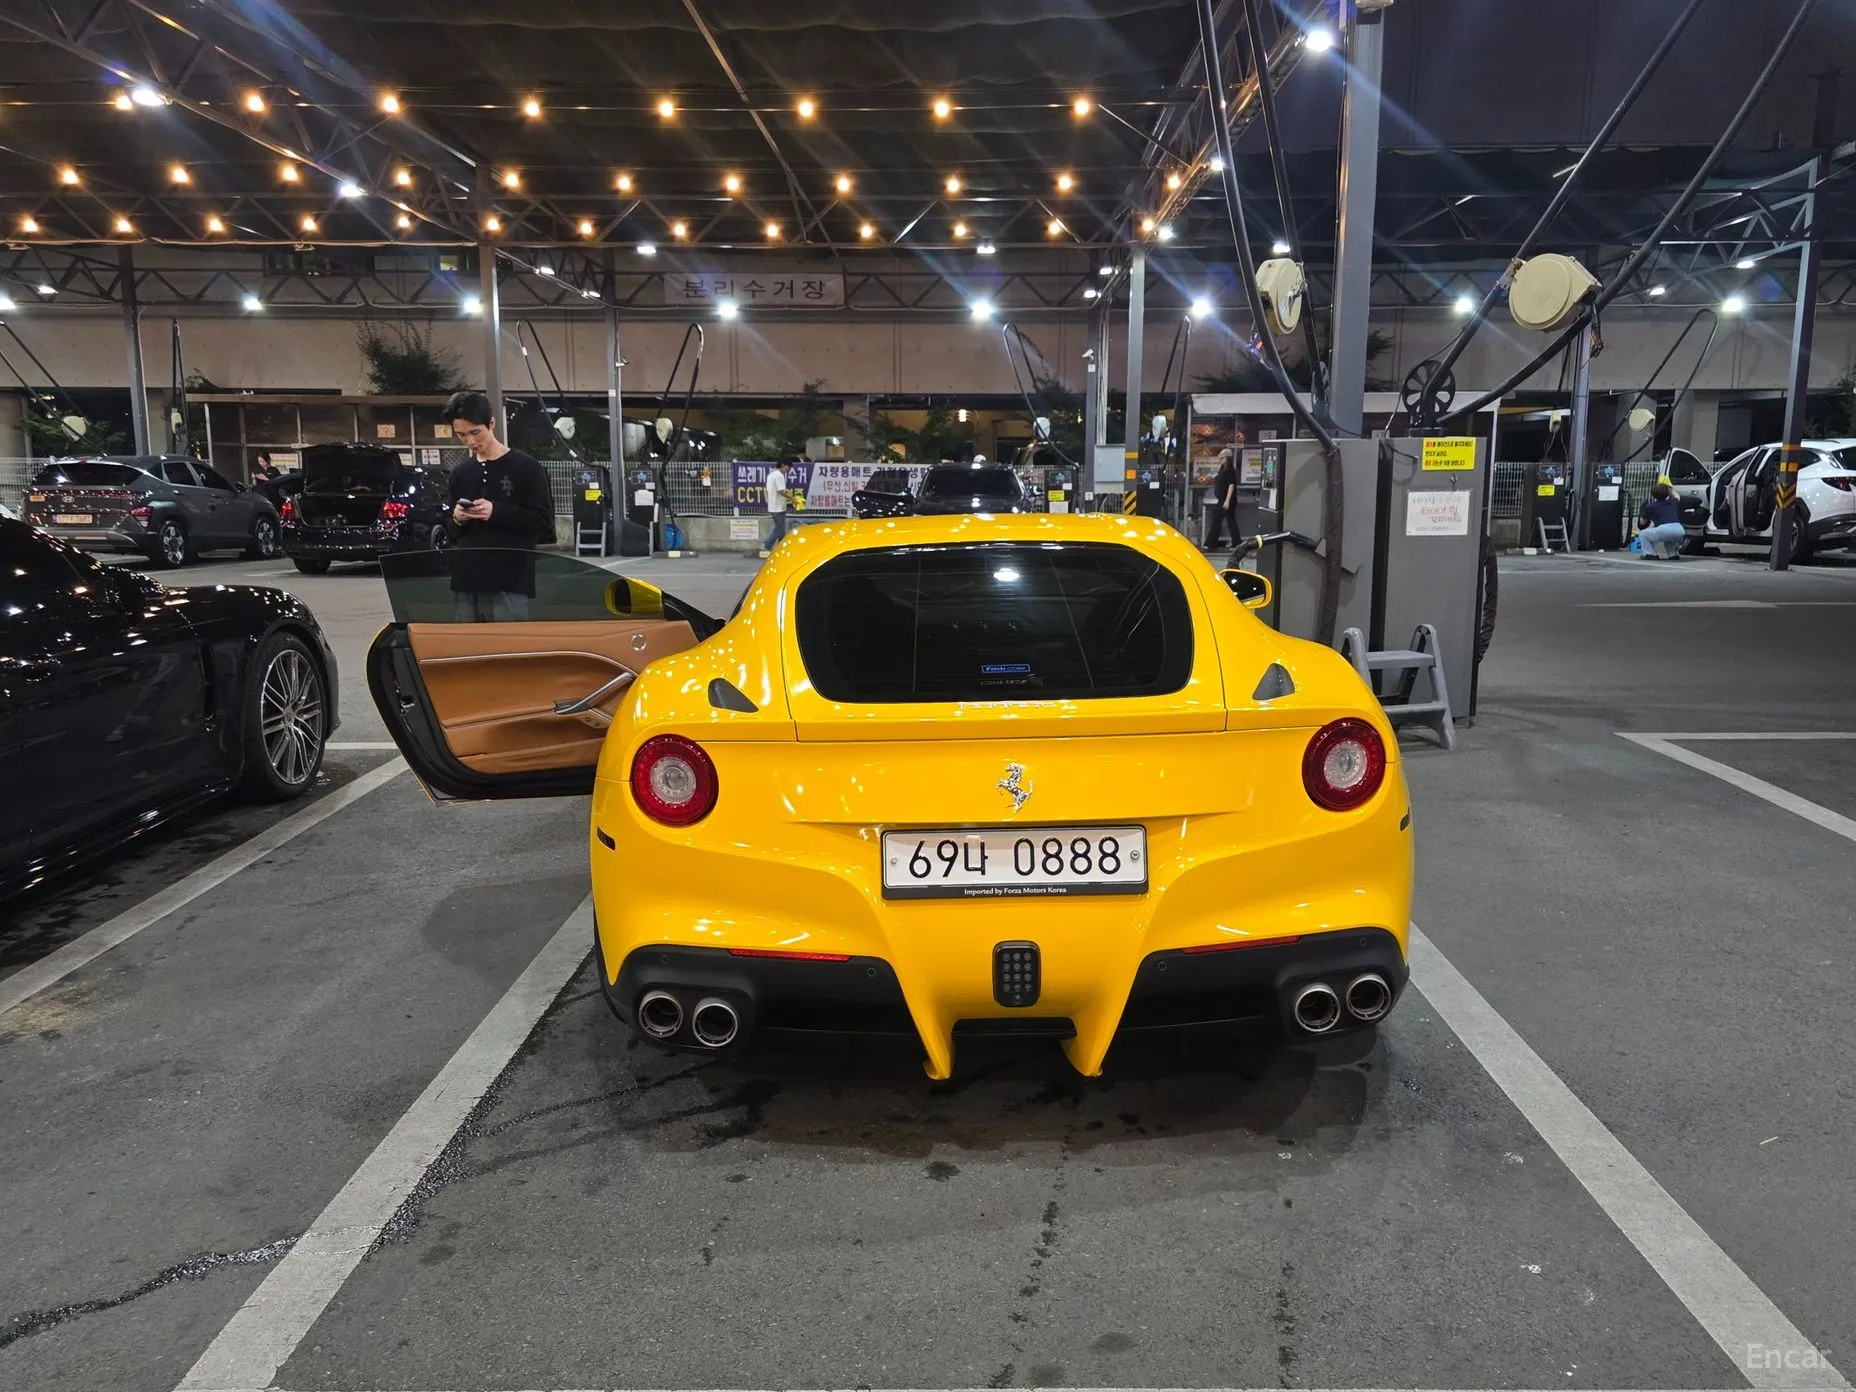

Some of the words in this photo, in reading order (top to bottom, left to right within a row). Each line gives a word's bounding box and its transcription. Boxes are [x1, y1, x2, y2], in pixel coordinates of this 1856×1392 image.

[682, 279, 826, 300] 분리수거장
[737, 466, 766, 483] 쓰레기
[818, 466, 872, 478] 차량용매트
[908, 838, 989, 879] 69나
[1013, 836, 1122, 876] 0888
[964, 888, 994, 896] Imported
[994, 888, 1003, 896] by
